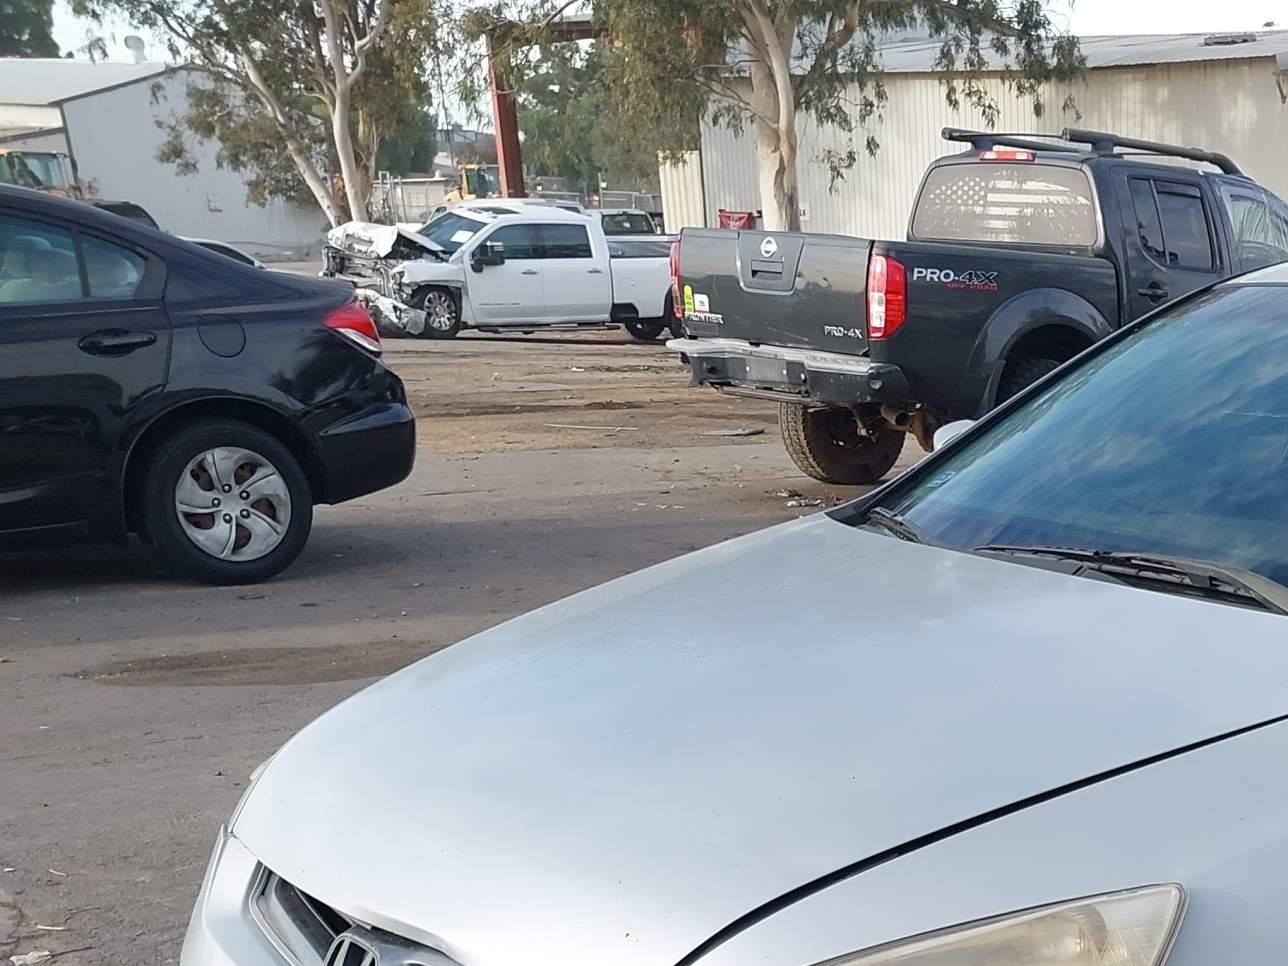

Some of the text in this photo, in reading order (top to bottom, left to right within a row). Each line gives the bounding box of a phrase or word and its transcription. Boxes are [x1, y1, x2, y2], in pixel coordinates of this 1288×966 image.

[912, 267, 998, 286] PRO-4X
[685, 311, 724, 324] FRONTIER
[824, 325, 863, 339] PRO-4X
